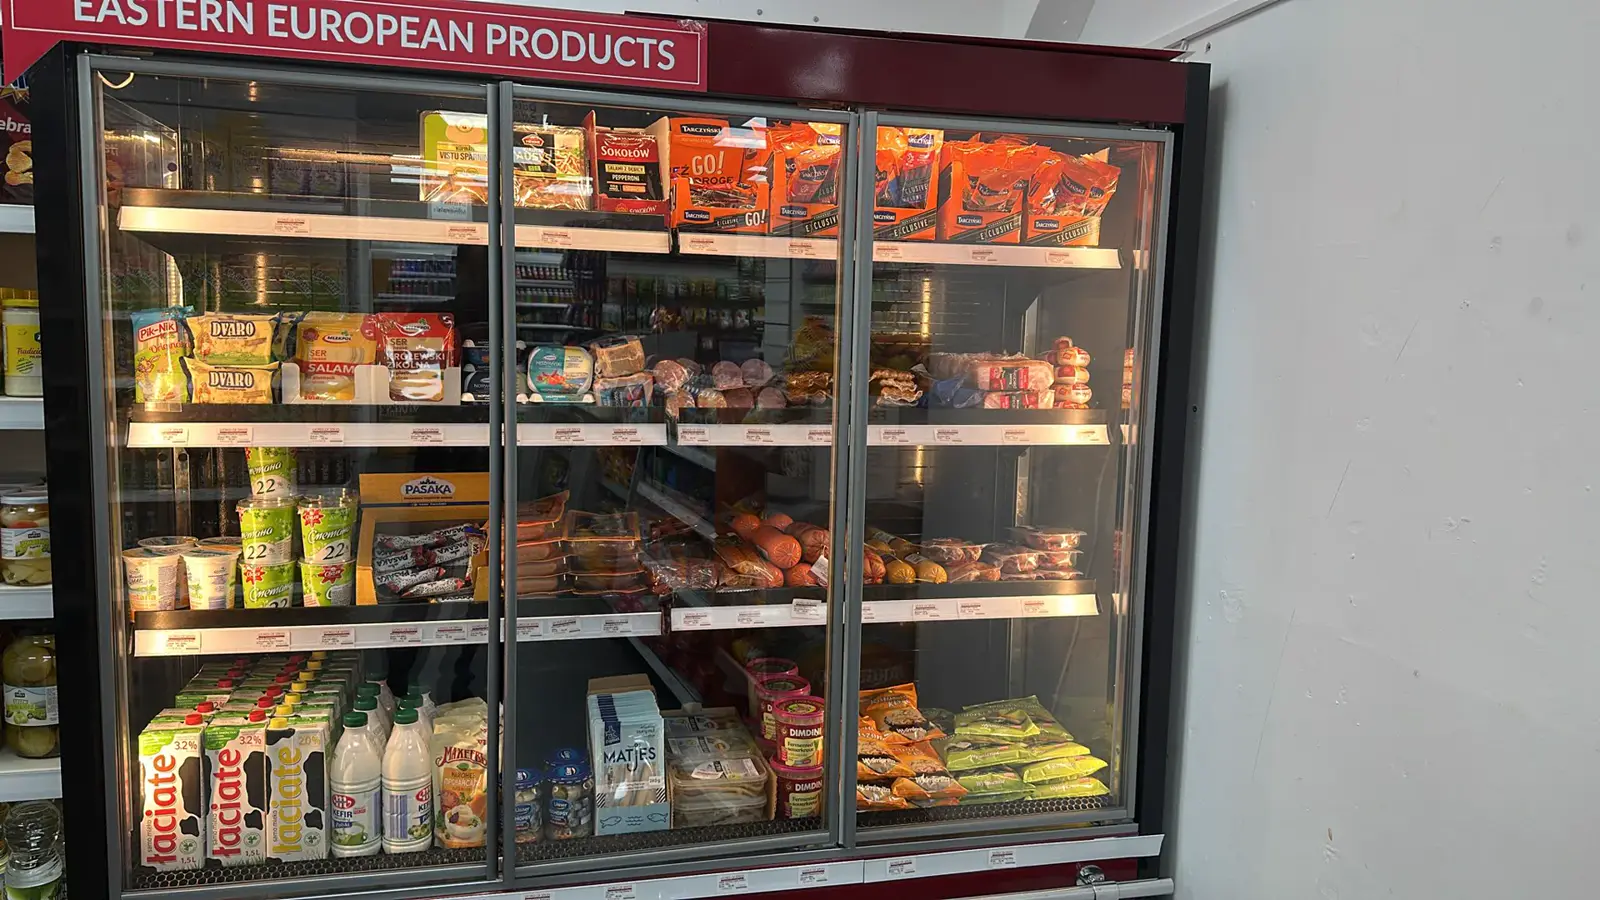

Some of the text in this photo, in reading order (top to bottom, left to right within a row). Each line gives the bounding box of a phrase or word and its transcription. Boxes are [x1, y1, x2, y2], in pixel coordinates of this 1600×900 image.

[74, 0, 676, 71] EASTERN EUROPEAN PRODUCTS
[682, 125, 721, 134] TARCZYŃSKI
[600, 145, 650, 159] SOKOŁÓW
[692, 150, 725, 176] GO!
[745, 209, 766, 227] GO!
[781, 206, 808, 216] TARCZYŃSKI
[957, 216, 982, 226] TARCZYŃSKI
[1056, 225, 1091, 244] EXCLUSIVE
[140, 322, 175, 339] Pik-Nik
[211, 321, 255, 337] DVARO
[390, 338, 408, 346] SER
[310, 349, 327, 357] SER
[209, 371, 254, 387] DVARO
[405, 484, 452, 495] PASAKA
[376, 553, 409, 567] PASAKA
[240, 735, 262, 745] 3.2%
[332, 808, 353, 818] KEFIR
